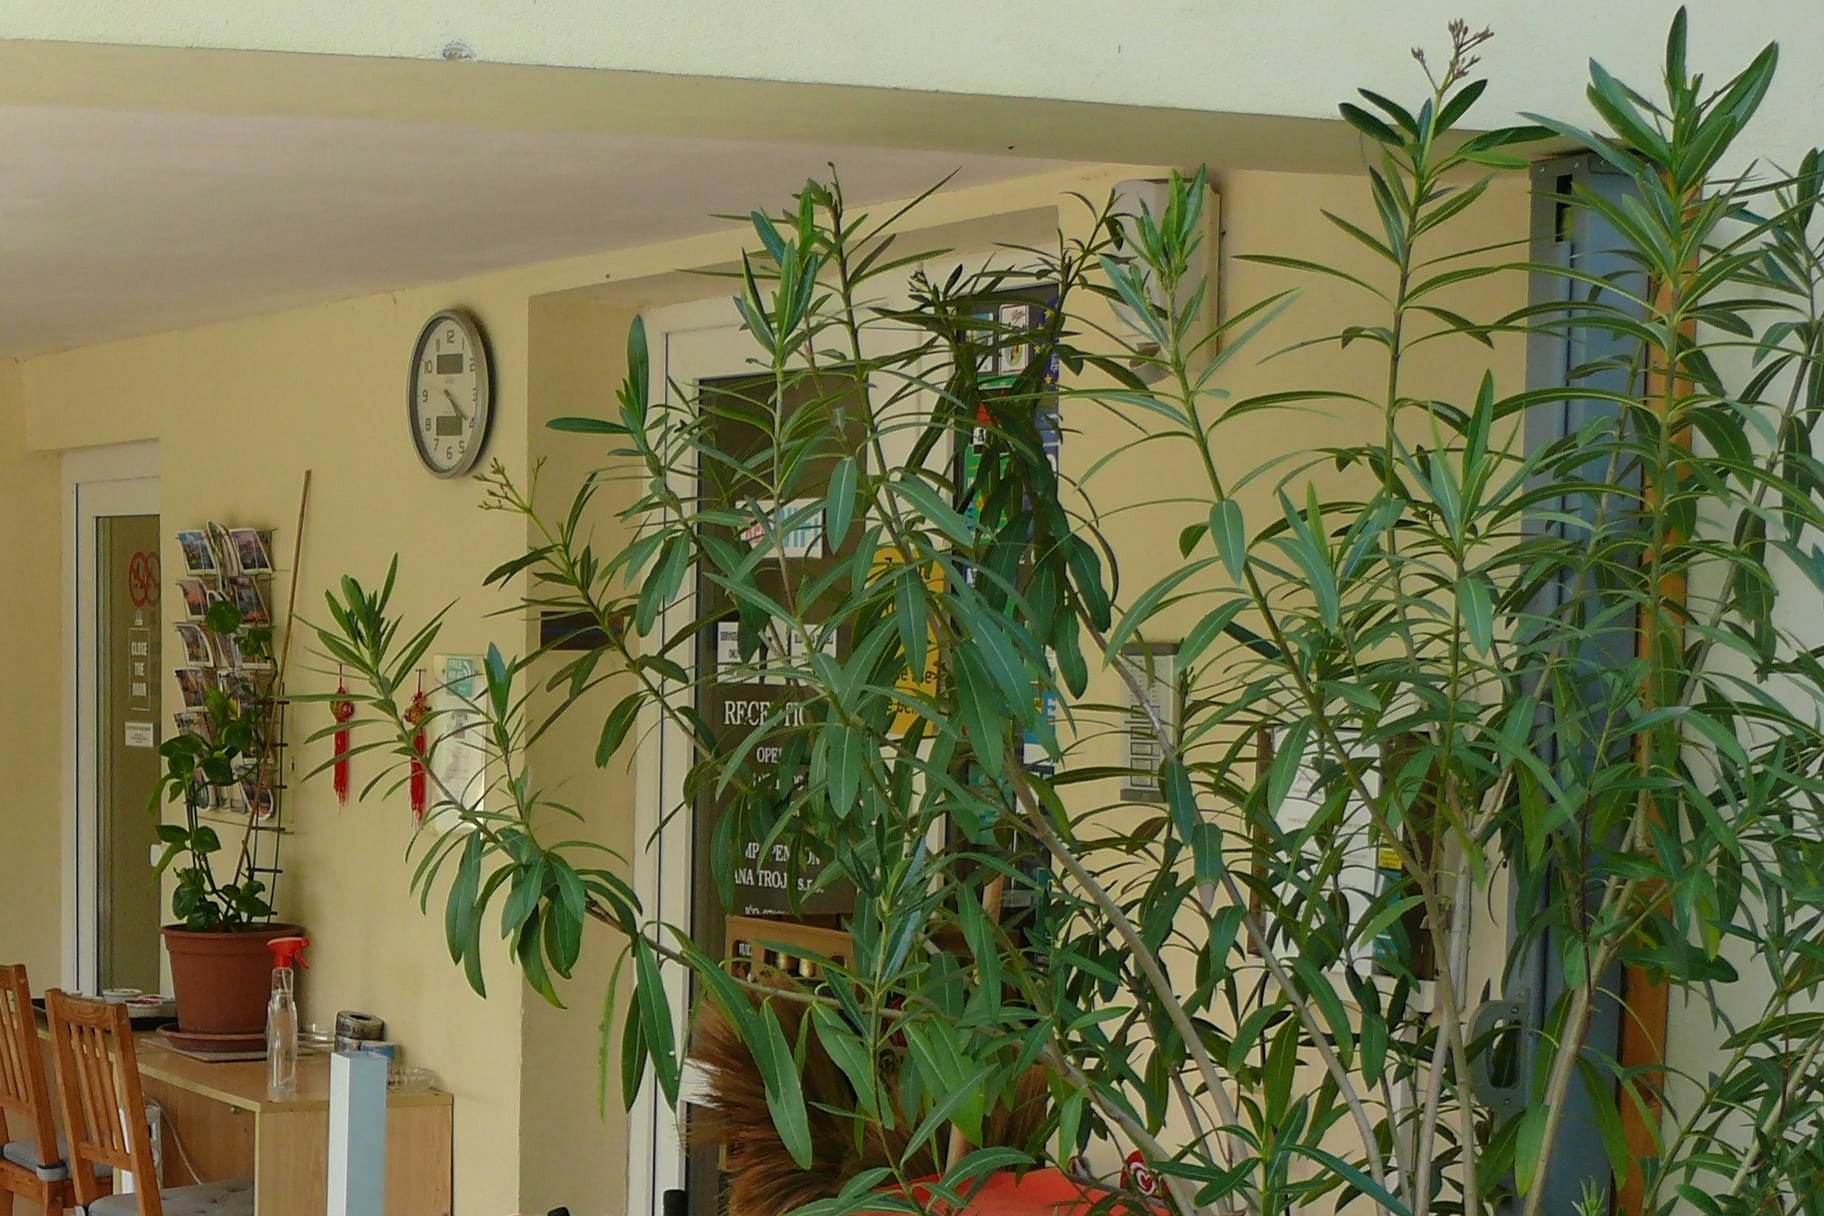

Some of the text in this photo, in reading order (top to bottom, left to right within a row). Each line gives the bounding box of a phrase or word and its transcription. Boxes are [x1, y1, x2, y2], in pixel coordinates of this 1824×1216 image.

[446, 330, 455, 344] 12
[756, 747, 782, 763] OPE
[735, 867, 754, 886] ANA
[757, 869, 788, 889] TROJ
